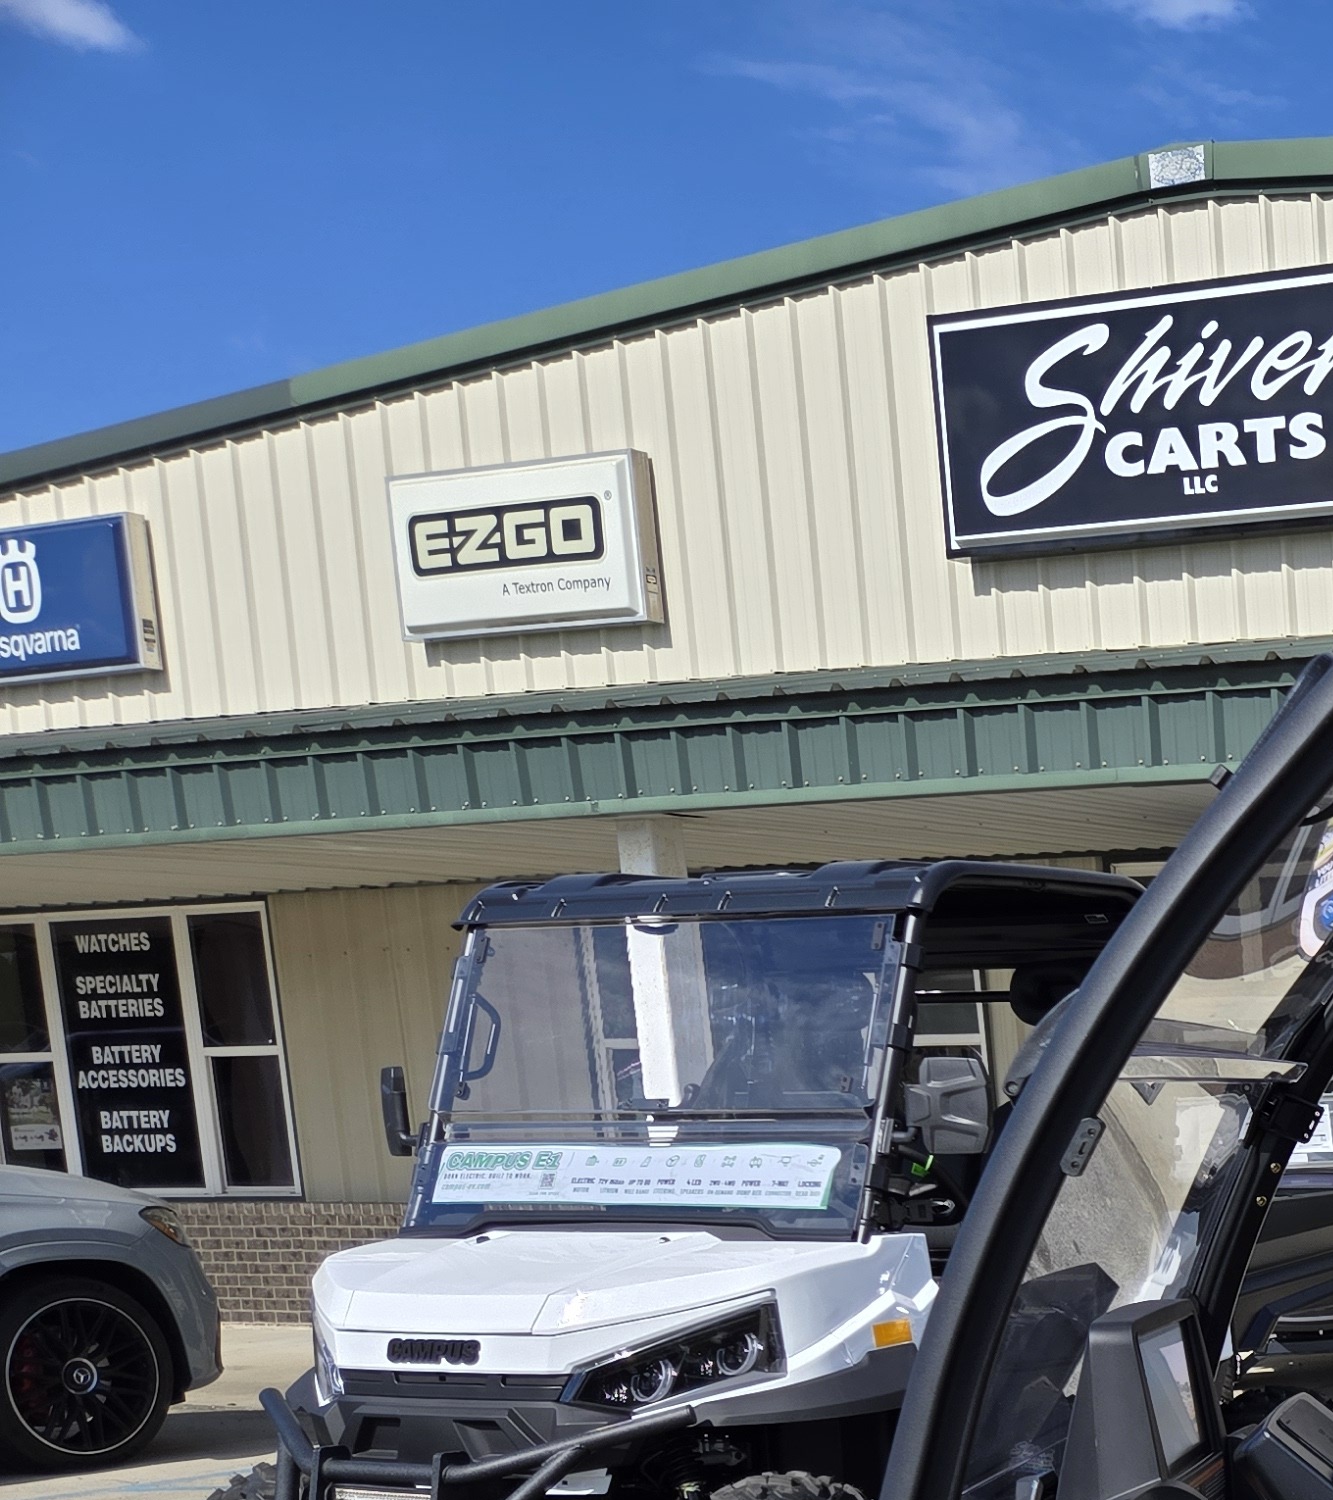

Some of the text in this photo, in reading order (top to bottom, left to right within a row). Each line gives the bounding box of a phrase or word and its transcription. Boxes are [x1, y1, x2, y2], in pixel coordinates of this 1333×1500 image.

[1105, 412, 1327, 478] CARTS
[1182, 476, 1219, 496] LLC
[414, 504, 596, 570] EZGO
[502, 577, 611, 596] A Textron Company
[0, 628, 81, 661] sqvarna
[74, 931, 150, 953] WATCHES
[75, 973, 160, 995] SPECIALTY
[79, 998, 164, 1019] BATTERIES
[91, 1044, 162, 1065] BATTERY
[78, 1068, 186, 1089] ACCESSORIES
[100, 1110, 170, 1129] BATTERY
[101, 1133, 176, 1153] BACKUPS
[446, 1150, 563, 1171] CAMPUS E1
[386, 1337, 481, 1365] CAMPUS
